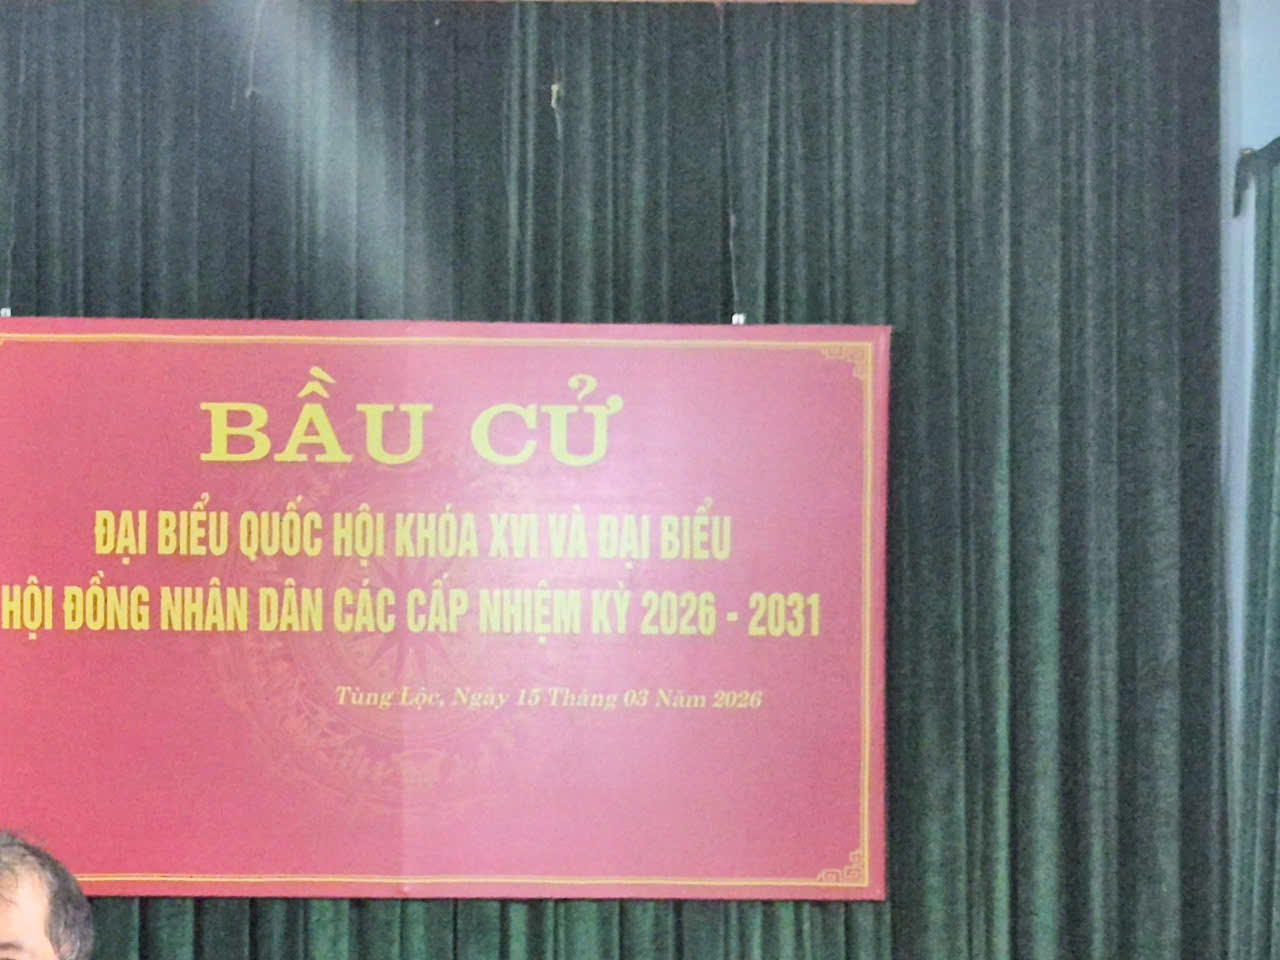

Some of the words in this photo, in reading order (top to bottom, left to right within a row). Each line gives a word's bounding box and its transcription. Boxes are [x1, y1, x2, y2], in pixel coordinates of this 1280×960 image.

[200, 366, 434, 465] BẦU
[471, 373, 625, 467] CỬ
[94, 509, 148, 566] ĐẠI
[157, 492, 229, 557] BIỂU
[239, 494, 323, 562] QUỐC
[333, 502, 385, 568] HỘI
[394, 502, 479, 559] KHÓA
[487, 511, 540, 559] XVI
[548, 503, 589, 560] VÀ
[598, 513, 651, 570] ĐẠI
[660, 496, 733, 561] BIỂU
[1, 574, 54, 641] HỘI
[62, 570, 151, 631] ĐỒNG
[160, 576, 249, 632] NHÂN
[258, 576, 324, 632] DÂN
[333, 578, 396, 633] CÁC
[406, 571, 469, 634] CẤP
[479, 578, 582, 646] NHIỆM
[591, 578, 632, 635] KỲ
[640, 590, 717, 636] 2026
[748, 591, 821, 638] 2031
[335, 685, 394, 710] Tùng
[451, 686, 510, 710] Ngày
[517, 686, 545, 707] 15
[548, 686, 619, 712] Tháng
[623, 688, 650, 708] 03
[655, 687, 707, 709] Năm
[711, 689, 764, 709] 2026
